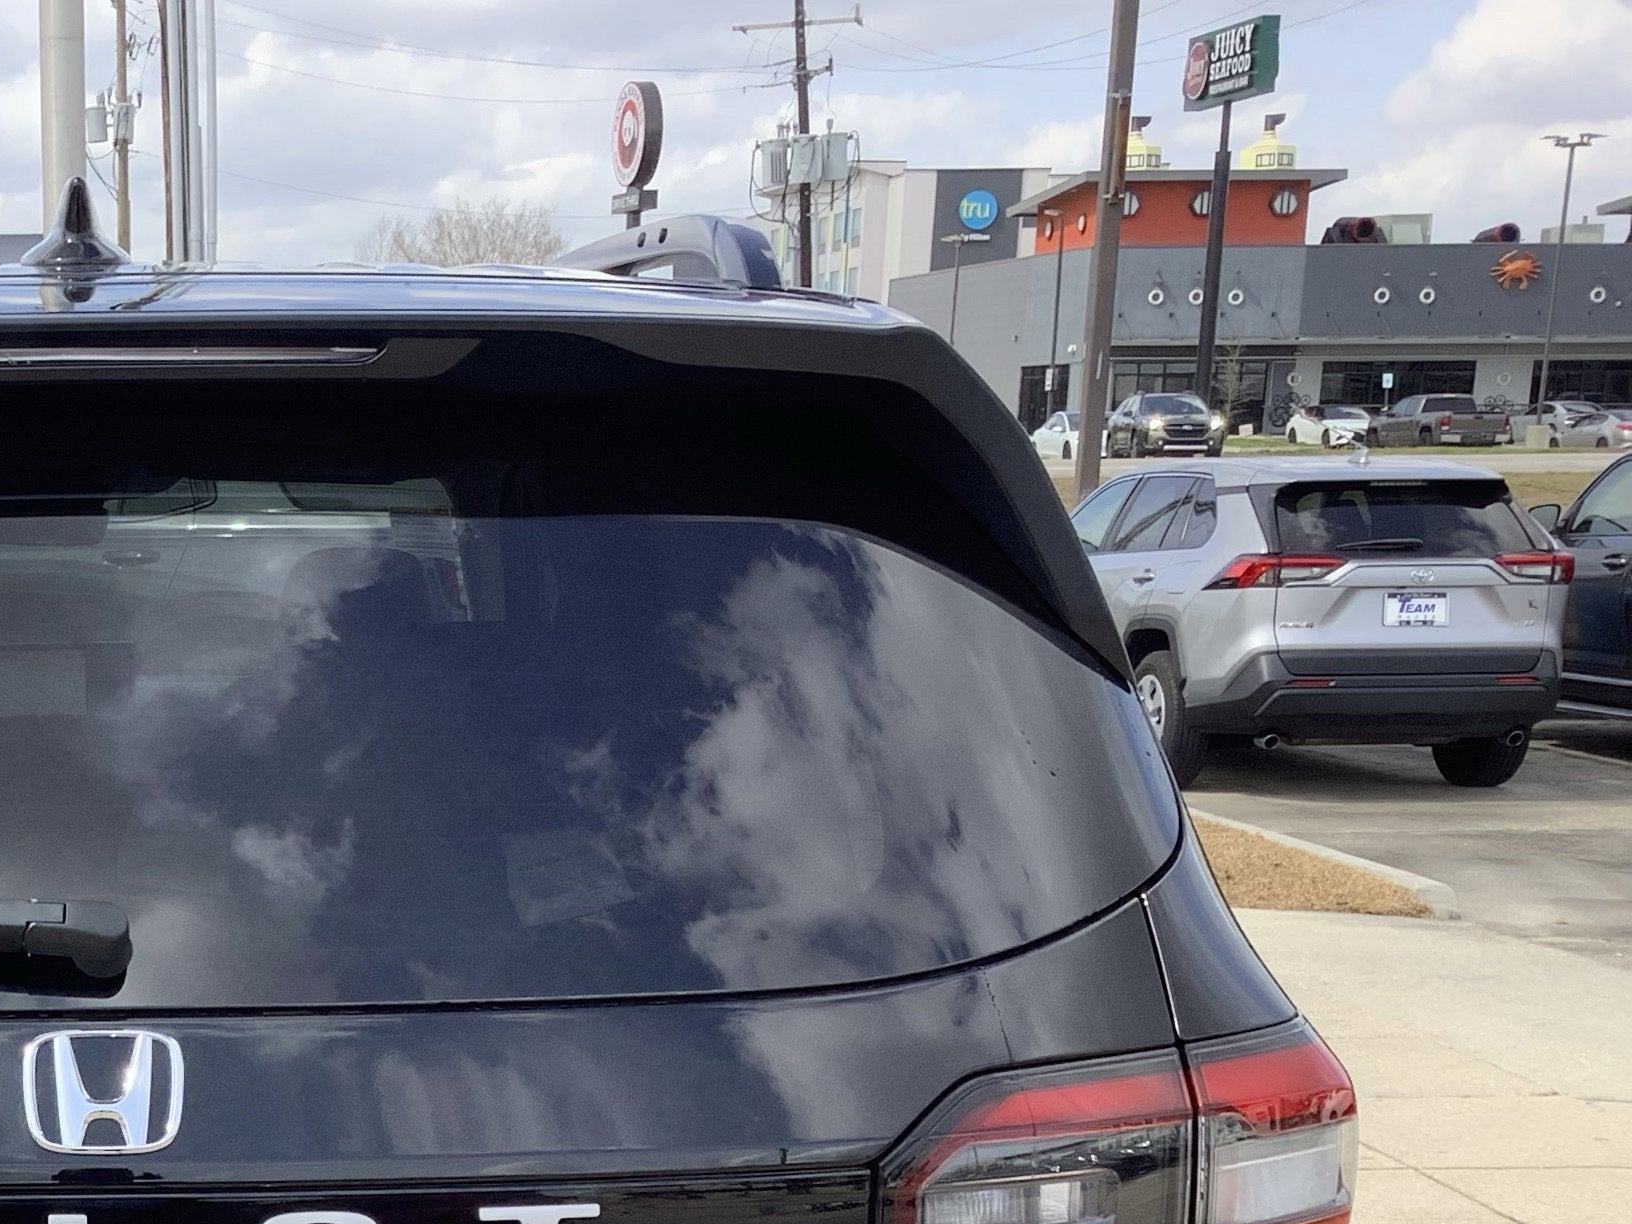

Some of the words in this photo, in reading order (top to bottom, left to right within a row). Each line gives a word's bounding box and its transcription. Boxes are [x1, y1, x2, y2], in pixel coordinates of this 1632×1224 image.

[1211, 24, 1255, 62] JUICY
[1209, 53, 1252, 81] SEAFOOD
[961, 199, 990, 218] tru
[1398, 596, 1436, 613] TEAM
